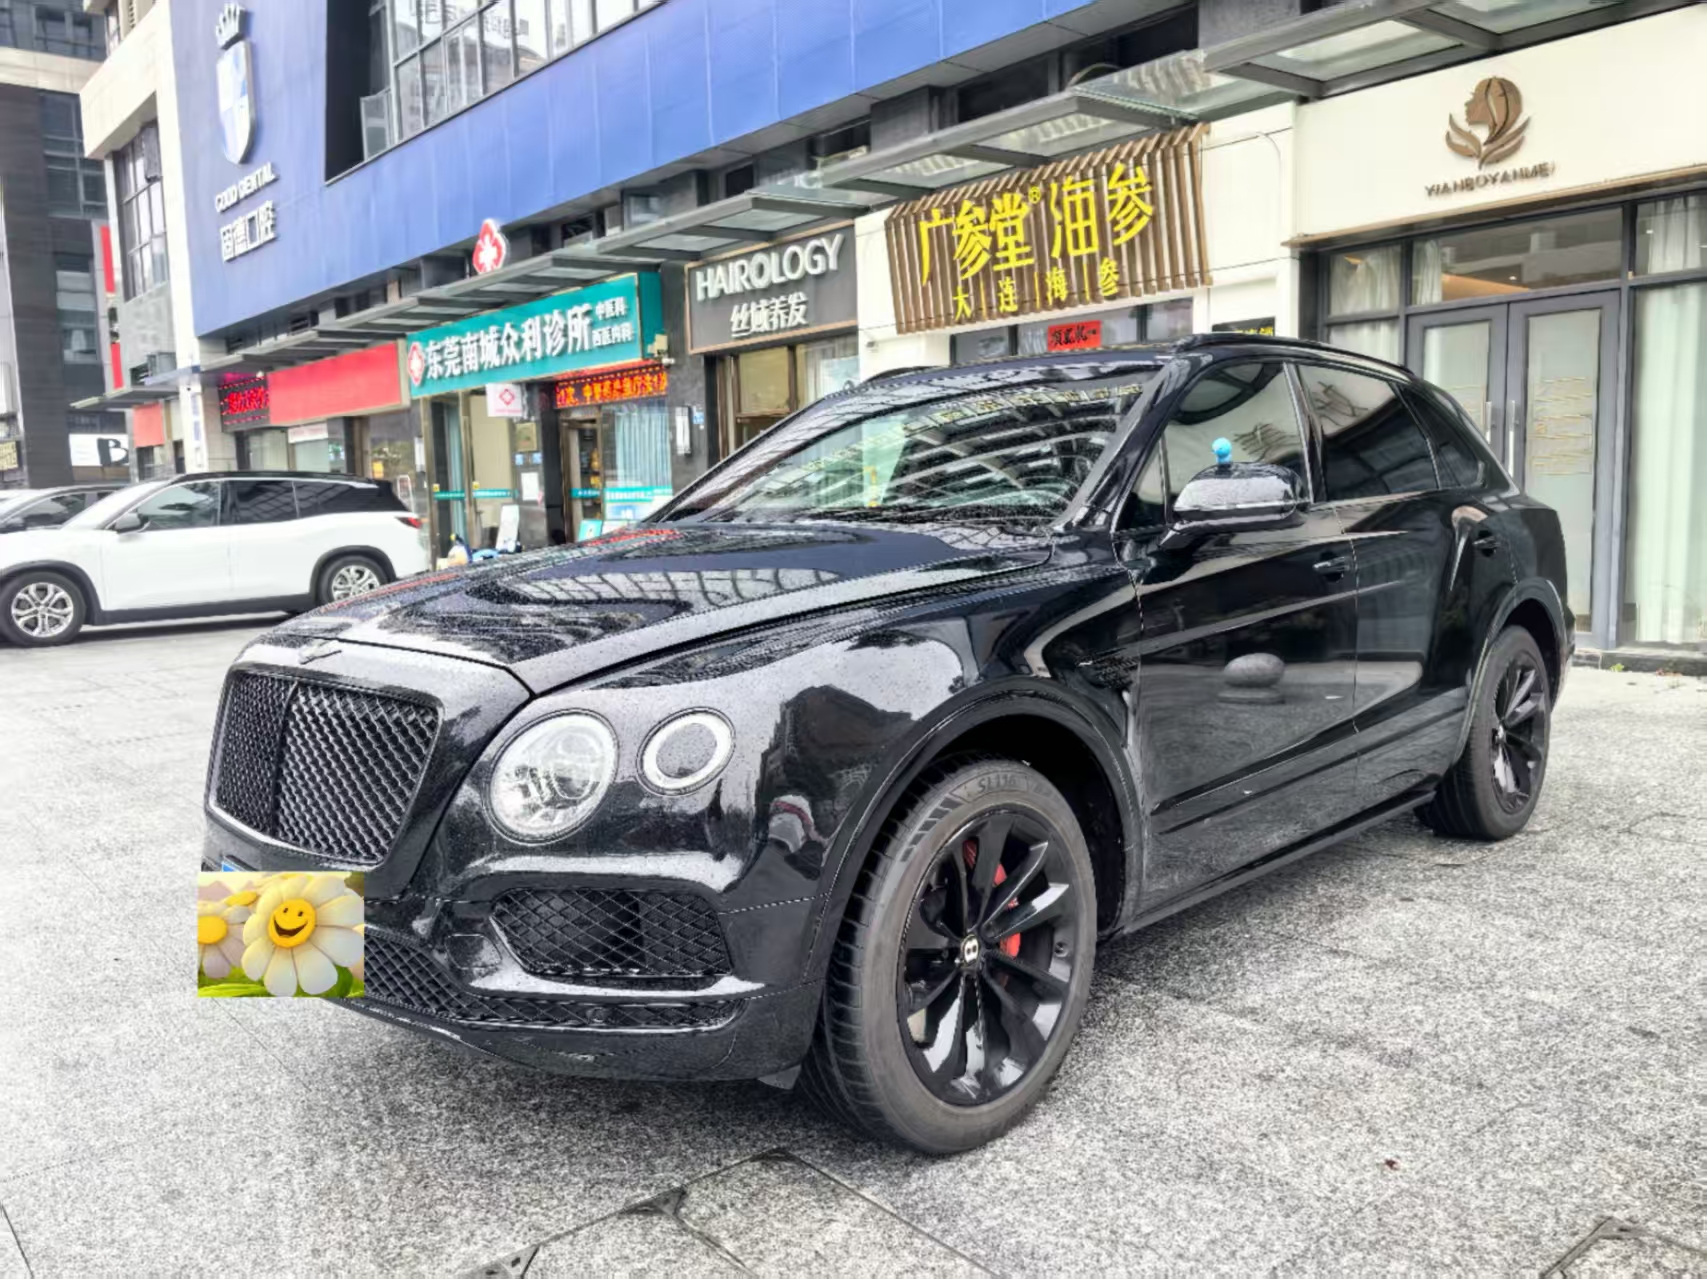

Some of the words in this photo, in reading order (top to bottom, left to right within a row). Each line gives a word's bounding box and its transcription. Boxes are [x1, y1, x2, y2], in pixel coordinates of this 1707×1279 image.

[695, 233, 845, 302] HAIROLOGY
[425, 302, 593, 380] 东莞南城众利诊所
[729, 291, 808, 339] 丝域养发
